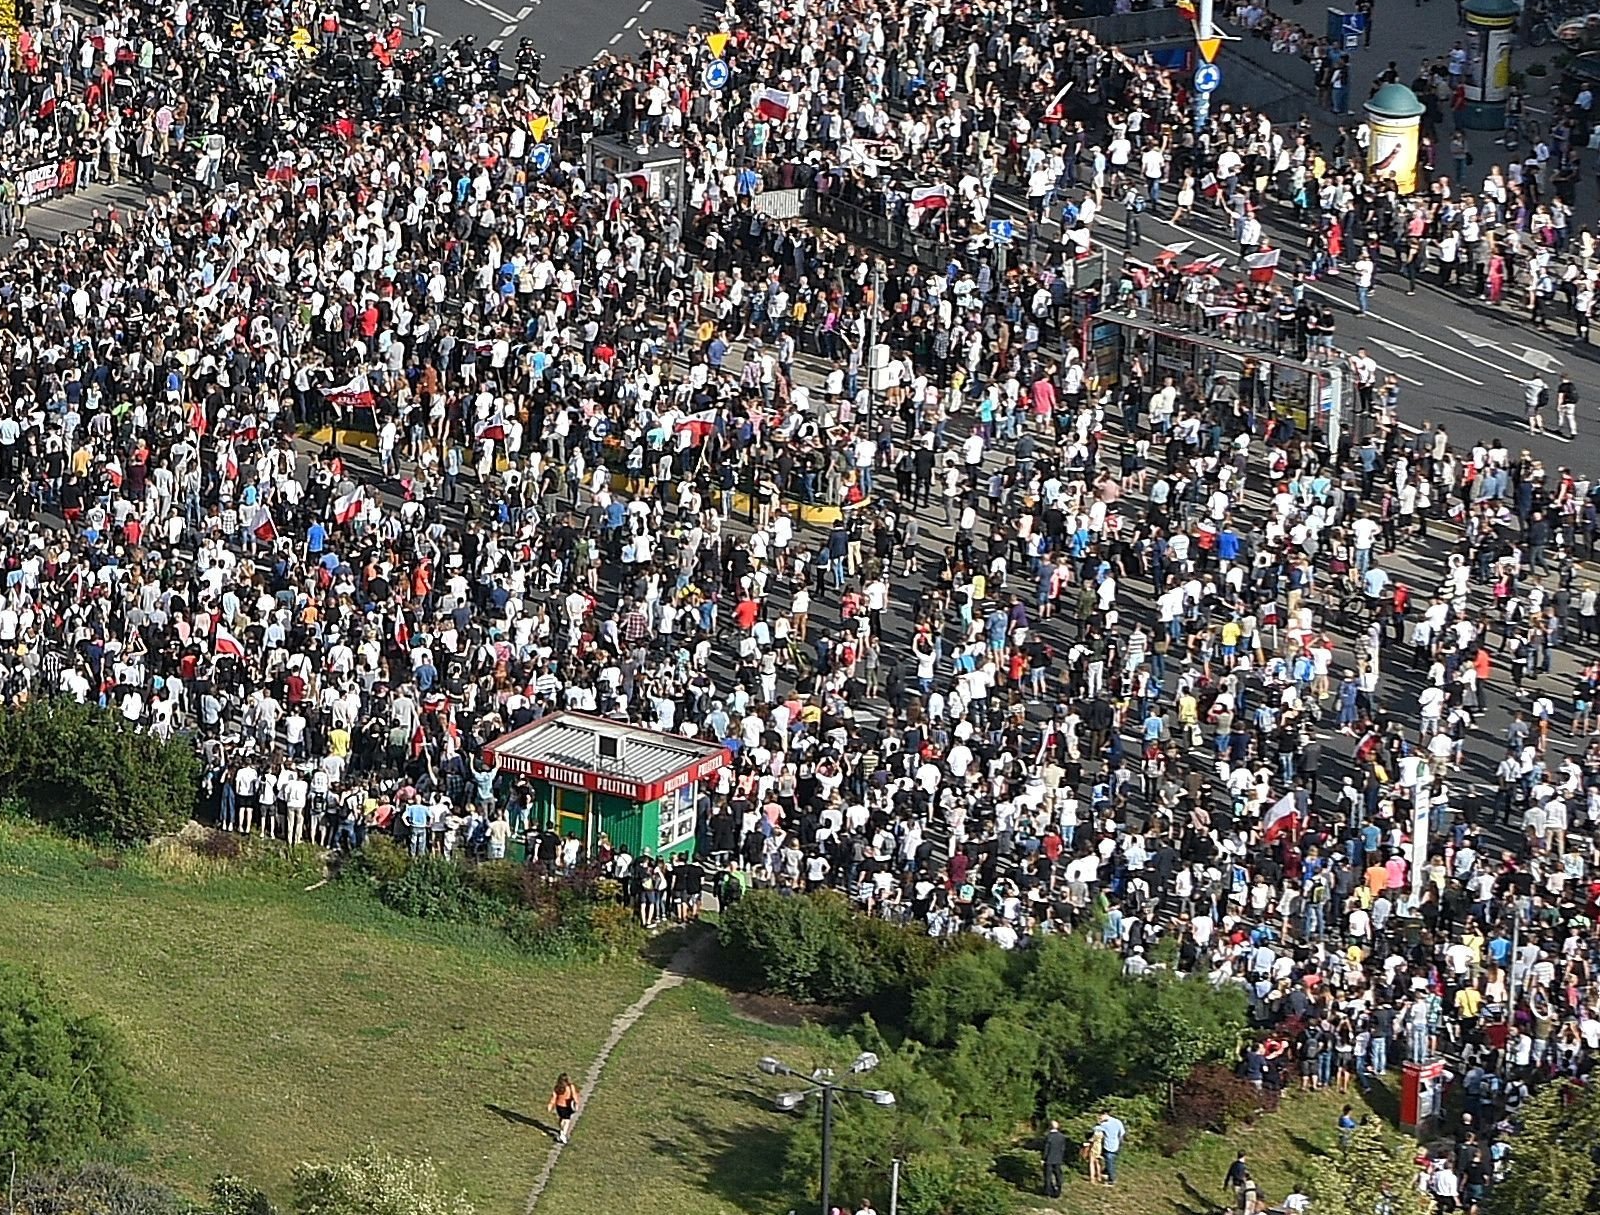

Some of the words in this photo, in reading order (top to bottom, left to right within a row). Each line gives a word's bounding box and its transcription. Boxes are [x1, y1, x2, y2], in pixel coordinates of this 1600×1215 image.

[496, 752, 532, 774] OLITYKA
[698, 755, 724, 776] POLITYKA
[544, 766, 584, 786] POLITYKA
[663, 771, 689, 793] POLITYKA
[597, 777, 637, 797] POLITYKA
